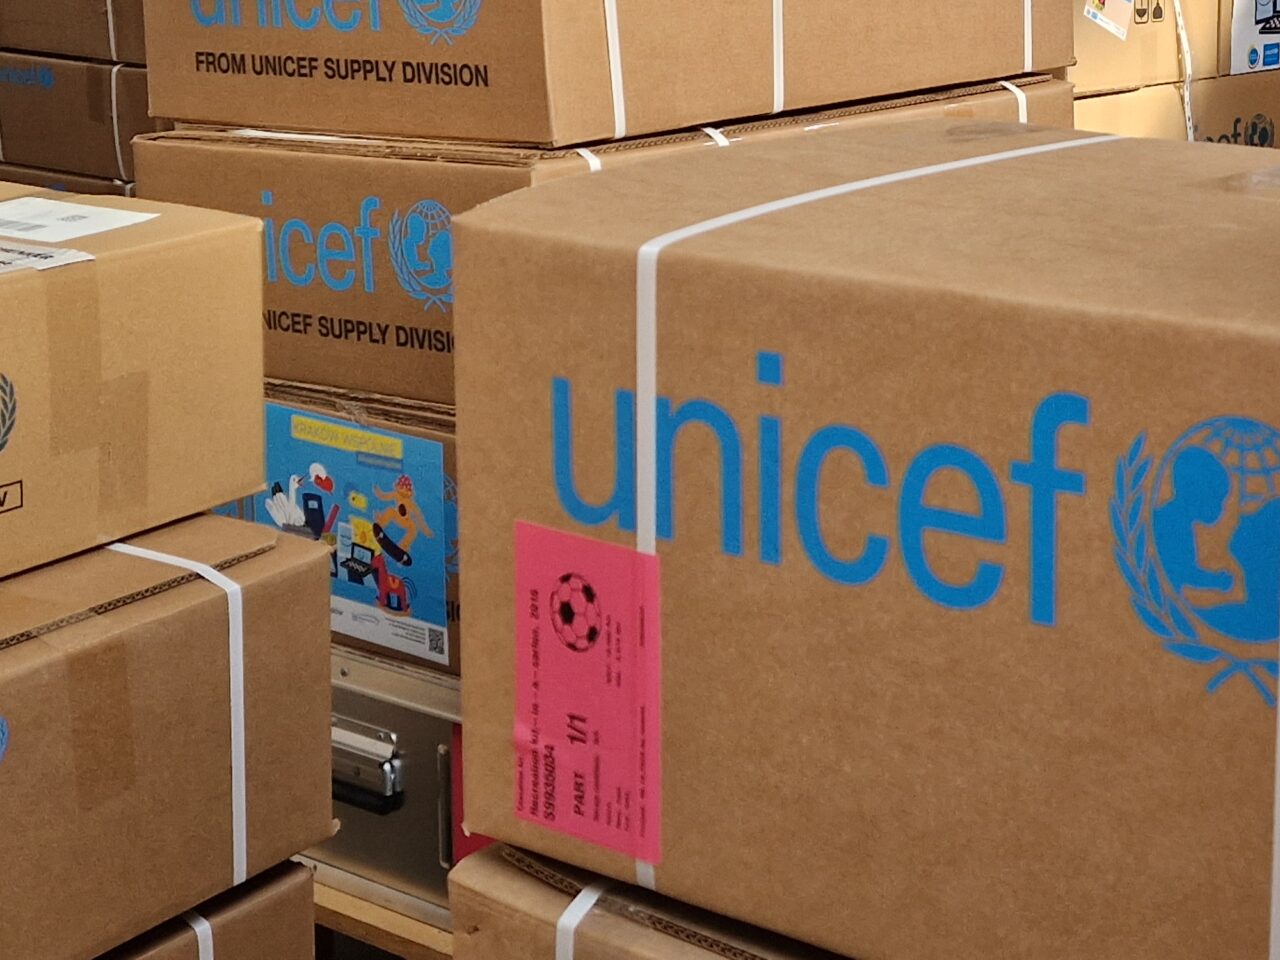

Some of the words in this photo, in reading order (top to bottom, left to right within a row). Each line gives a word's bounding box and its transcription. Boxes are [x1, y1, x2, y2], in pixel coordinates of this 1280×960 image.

[195, 52, 247, 76] FROM
[250, 54, 320, 80] UNICEF
[323, 57, 396, 85] SUPPLY
[402, 60, 490, 89] DIVISION
[261, 190, 382, 294] icef
[262, 309, 313, 336] NICEF
[318, 315, 390, 346] SUPPLY
[395, 324, 454, 354] DIVISI
[552, 350, 1092, 628] unicef
[567, 712, 588, 746] 1/1
[573, 772, 586, 817] PART
